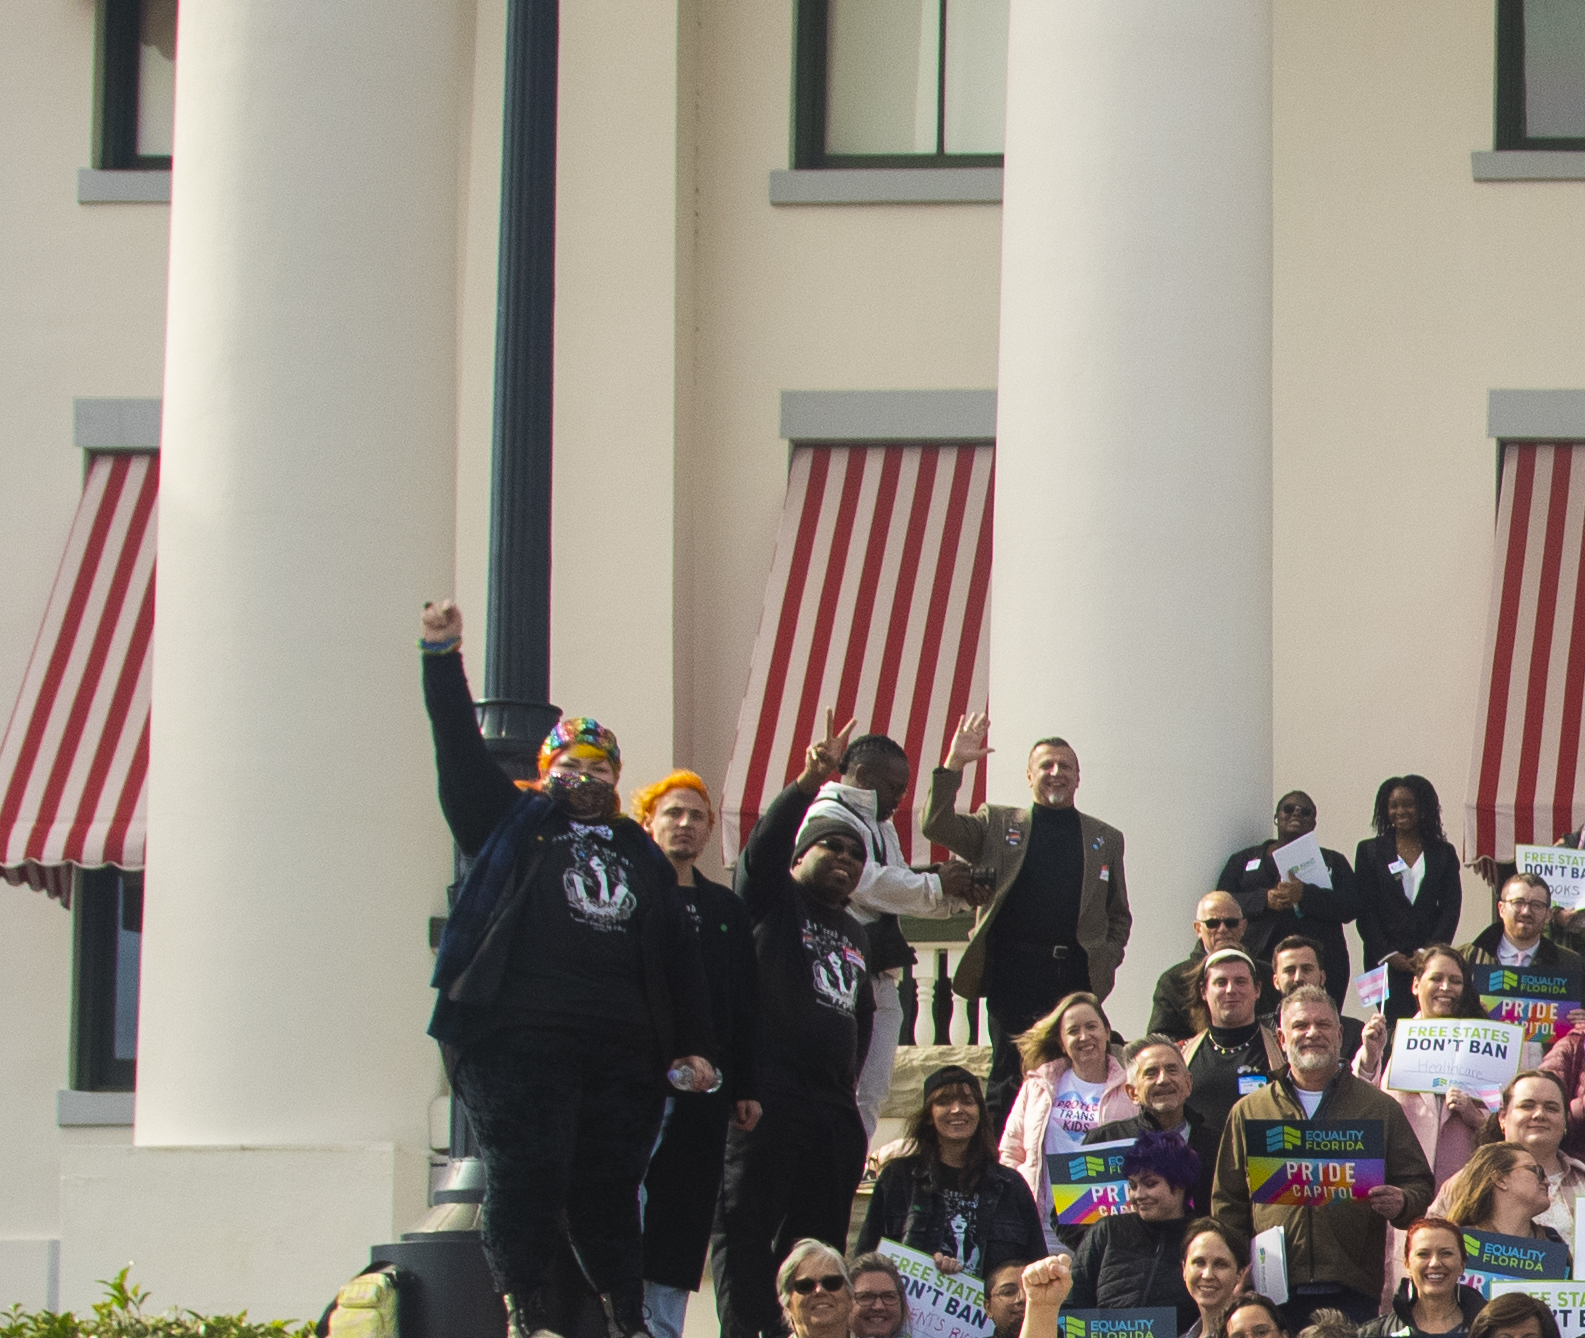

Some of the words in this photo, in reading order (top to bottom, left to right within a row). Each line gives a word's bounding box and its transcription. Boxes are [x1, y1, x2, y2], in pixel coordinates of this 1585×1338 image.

[1524, 851, 1554, 863] FREE
[1525, 862, 1566, 877] DON'T
[1502, 999, 1559, 1019] PRIDE
[1406, 1024, 1448, 1037] FREE
[1452, 1027, 1509, 1041] STATES
[1405, 1036, 1463, 1056] DON'T
[1468, 1039, 1508, 1060] BAN
[1059, 1109, 1095, 1121] TRANS
[1062, 1120, 1090, 1133] KIDS
[1286, 1161, 1355, 1181] PRIDE
[1291, 1185, 1356, 1200] CAPITOL
[1484, 1242, 1546, 1262] EQUALITY
[1483, 1254, 1544, 1272] FLORIDA
[945, 1297, 988, 1330] BAN
